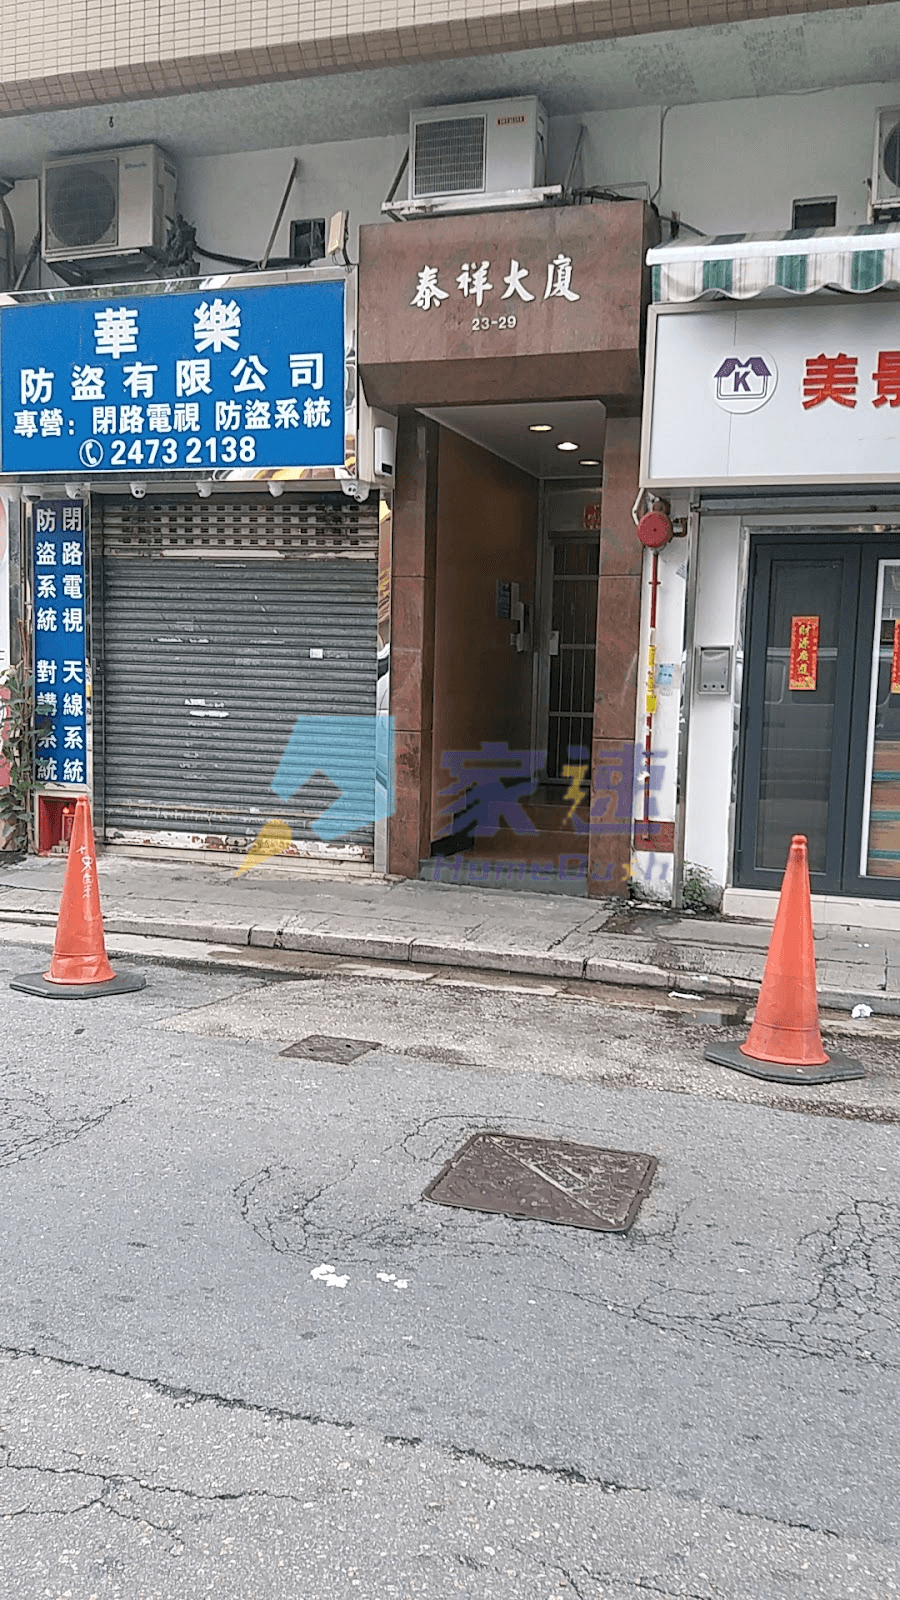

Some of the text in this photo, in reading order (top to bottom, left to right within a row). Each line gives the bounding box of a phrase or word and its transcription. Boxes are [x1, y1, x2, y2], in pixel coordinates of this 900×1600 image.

[410, 254, 580, 310] 泰祥大廈
[94, 298, 242, 359] 華樂
[471, 315, 517, 331] 23-29
[20, 353, 324, 404] 防盜有限公司
[92, 403, 200, 435] 閉路電視
[214, 396, 331, 431] 防盜系統
[110, 436, 256, 466] 2473 2138
[36, 507, 58, 633] 防盜系統
[62, 506, 84, 782] 閉路電視 天線系統
